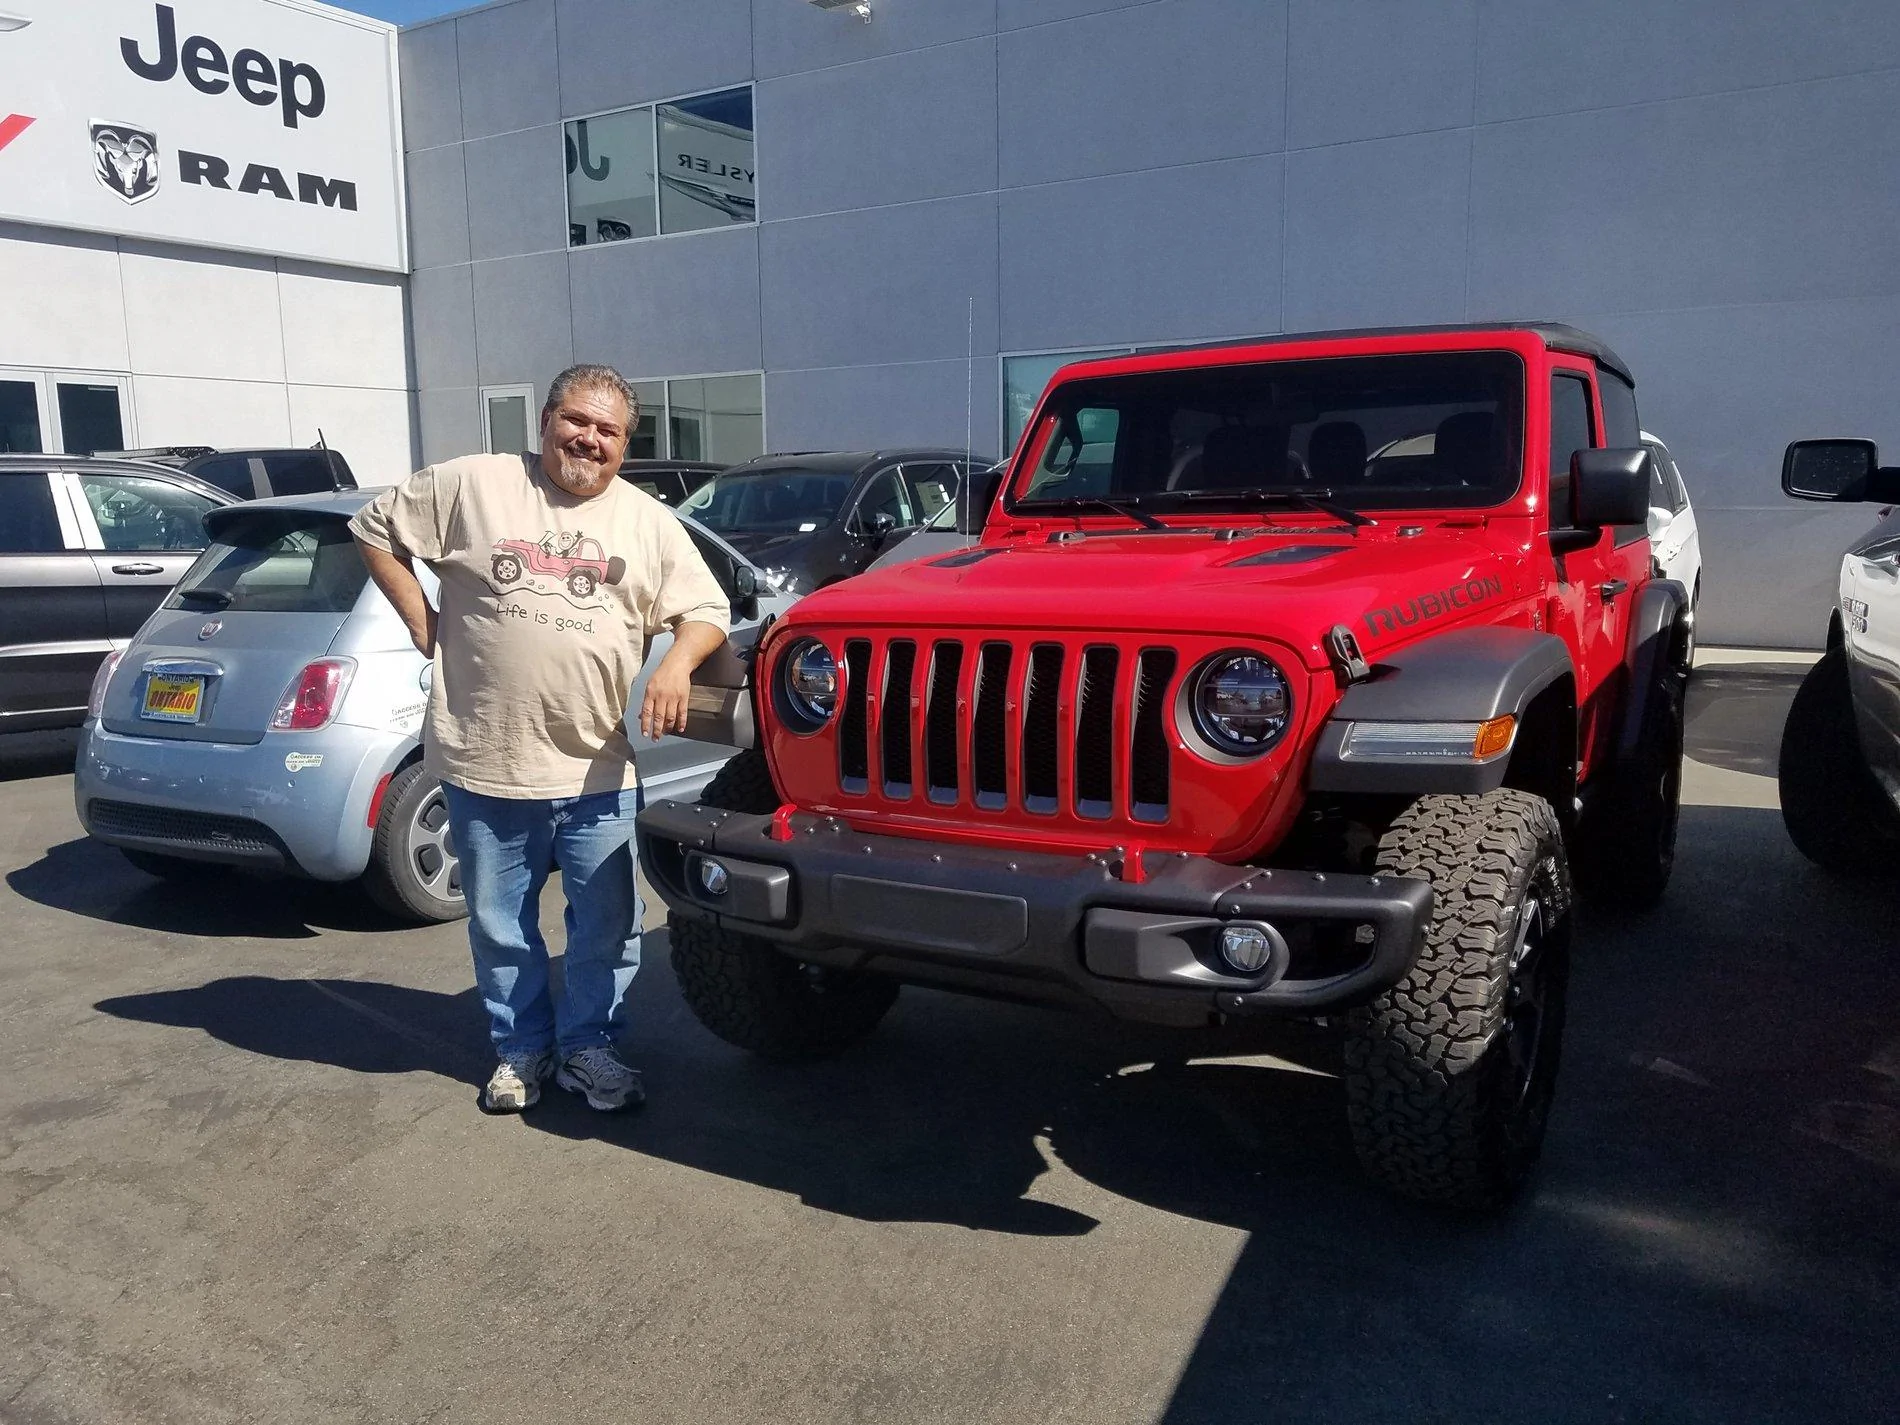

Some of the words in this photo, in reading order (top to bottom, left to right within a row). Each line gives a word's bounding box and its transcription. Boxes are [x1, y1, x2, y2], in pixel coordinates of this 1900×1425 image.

[120, 3, 325, 129] Jeep
[178, 149, 358, 211] RAM
[497, 603, 528, 618] Life
[534, 610, 549, 624] is
[555, 617, 595, 634] good.
[1364, 575, 1502, 637] RUBICON
[150, 690, 196, 710] ONTARIO
